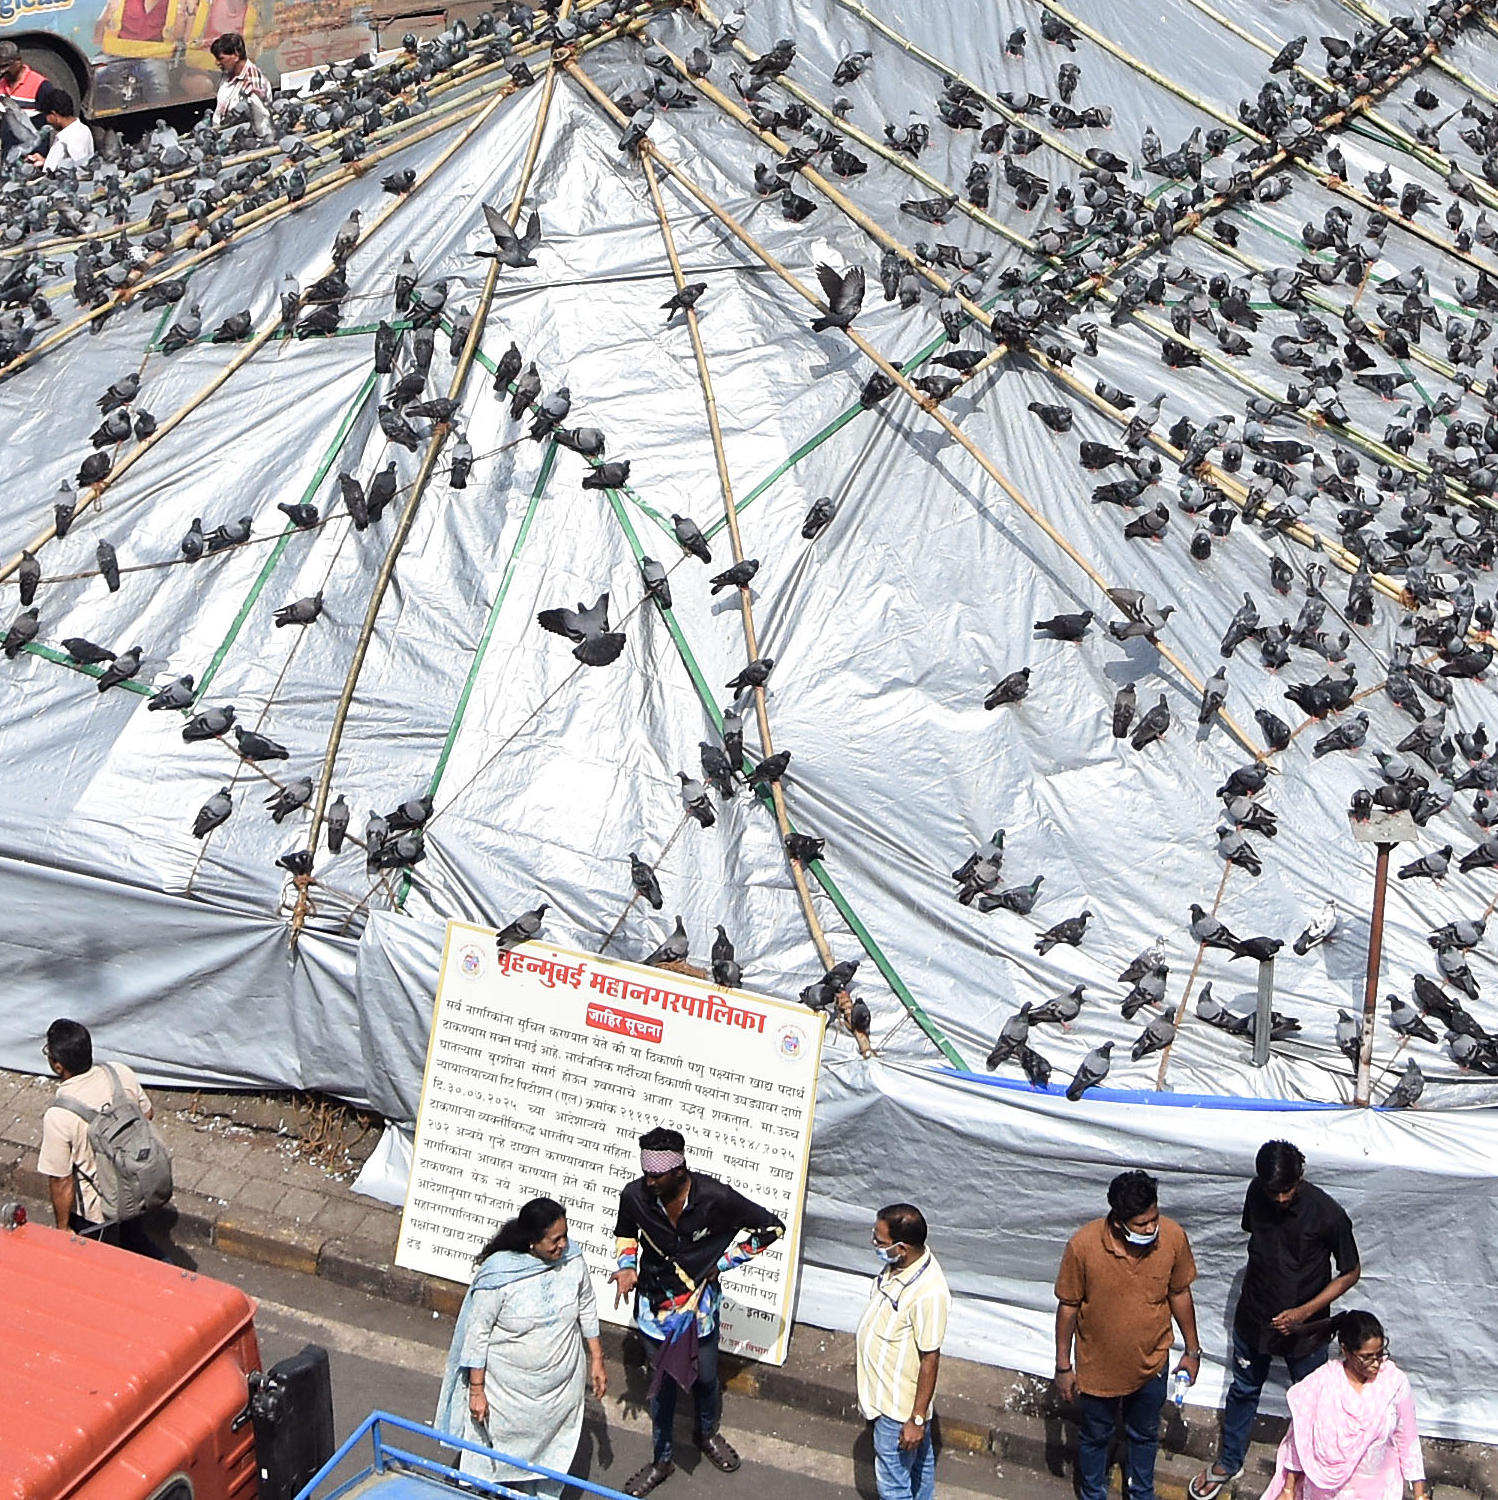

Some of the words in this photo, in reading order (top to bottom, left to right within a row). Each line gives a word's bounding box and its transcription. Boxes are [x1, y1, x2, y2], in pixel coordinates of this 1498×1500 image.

[498, 951, 586, 989] बृहन्मुंबई
[590, 973, 767, 1033] महानगरपालिका
[587, 1007, 623, 1028] जाहिर
[624, 1017, 663, 1038] सूचना
[437, 1060, 498, 1083] न्यायालयाच्या
[516, 1077, 553, 1098] पिटीशन
[585, 1098, 617, 1114] क्रमांक
[440, 1039, 483, 1058] घातल्यास
[562, 1072, 588, 1086] होऊन
[594, 1079, 636, 1098] श्वसनाचे
[643, 1092, 673, 1107] आजार
[443, 1020, 487, 1039] टाकण्यास
[489, 1032, 512, 1045] सक्त
[514, 1038, 537, 1053] मनाई
[541, 1045, 559, 1057] आहे.
[565, 1051, 614, 1072] सार्वजनिक
[616, 1064, 652, 1081] गर्दीच्या
[654, 1071, 692, 1091] ठिकाणी
[695, 1084, 731, 1101] पक्ष्यांना
[733, 1094, 779, 1112] उघड्यावर
[781, 1106, 802, 1119] दाणे
[466, 1004, 514, 1025] नागरिकांना
[549, 1027, 589, 1045] करण्यात
[592, 1037, 608, 1050] येते
[612, 1041, 626, 1054] की
[630, 1047, 642, 1058] या
[645, 1048, 684, 1069] ठिकाणी
[688, 1061, 705, 1076] पशु
[709, 1067, 745, 1084] पक्ष्यांना
[749, 1077, 774, 1092] खाद्य
[778, 1084, 805, 1099] पदार्थ
[420, 1159, 463, 1177] टाकण्यात
[471, 1172, 487, 1184] येऊ
[496, 1179, 511, 1190] नये
[424, 1139, 472, 1158] नागरिकांना
[478, 1154, 513, 1170] आवाहन
[583, 1179, 597, 1192] की
[428, 1122, 449, 1131] २७२
[457, 1128, 484, 1141] अन्वये
[510, 1141, 541, 1157] दाखल
[545, 1151, 604, 1173] करण्याबाबत
[528, 1104, 545, 1116] च्या
[556, 1112, 607, 1132] आदेशान्वये
[723, 1154, 760, 1172] पक्ष्यांना
[770, 1166, 794, 1181] खाद्य
[540, 1129, 575, 1144] भारतीय
[577, 1137, 600, 1151] न्याय
[782, 1191, 791, 1200] व
[407, 1239, 421, 1250] दंड
[414, 1198, 485, 1224] महानगरपालिका
[760, 1289, 777, 1303] पशु
[419, 1180, 472, 1199] आदेशानुसार
[474, 1193, 514, 1211] फौजदारी
[739, 1256, 780, 1283] बृहन्मुंबई
[410, 1218, 440, 1233] पक्षांना
[442, 1226, 465, 1240] खाद्य
[746, 1306, 776, 1323] इतका
